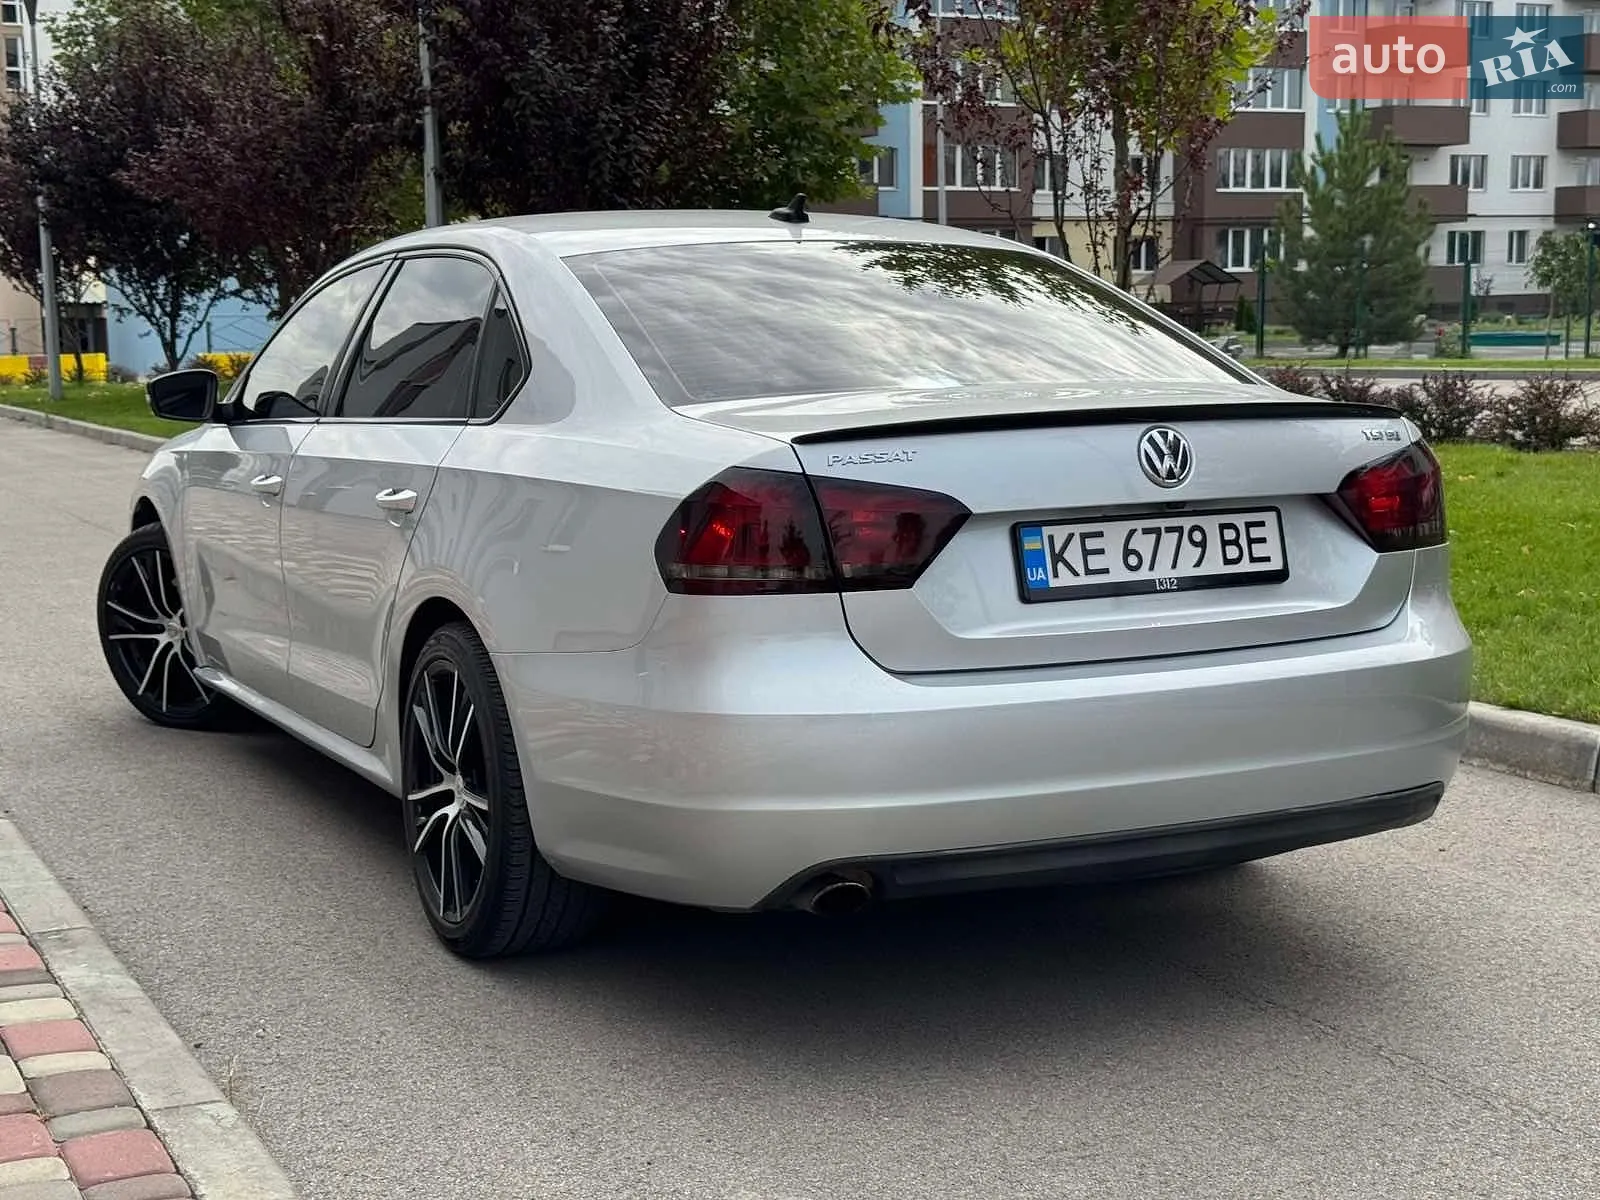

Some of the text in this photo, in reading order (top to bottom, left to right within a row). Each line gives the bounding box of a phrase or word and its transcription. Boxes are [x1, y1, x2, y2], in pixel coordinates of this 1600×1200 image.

[827, 449, 918, 467] PASSAT
[1047, 520, 1272, 579] KE 6779 BE
[1027, 568, 1047, 582] UA
